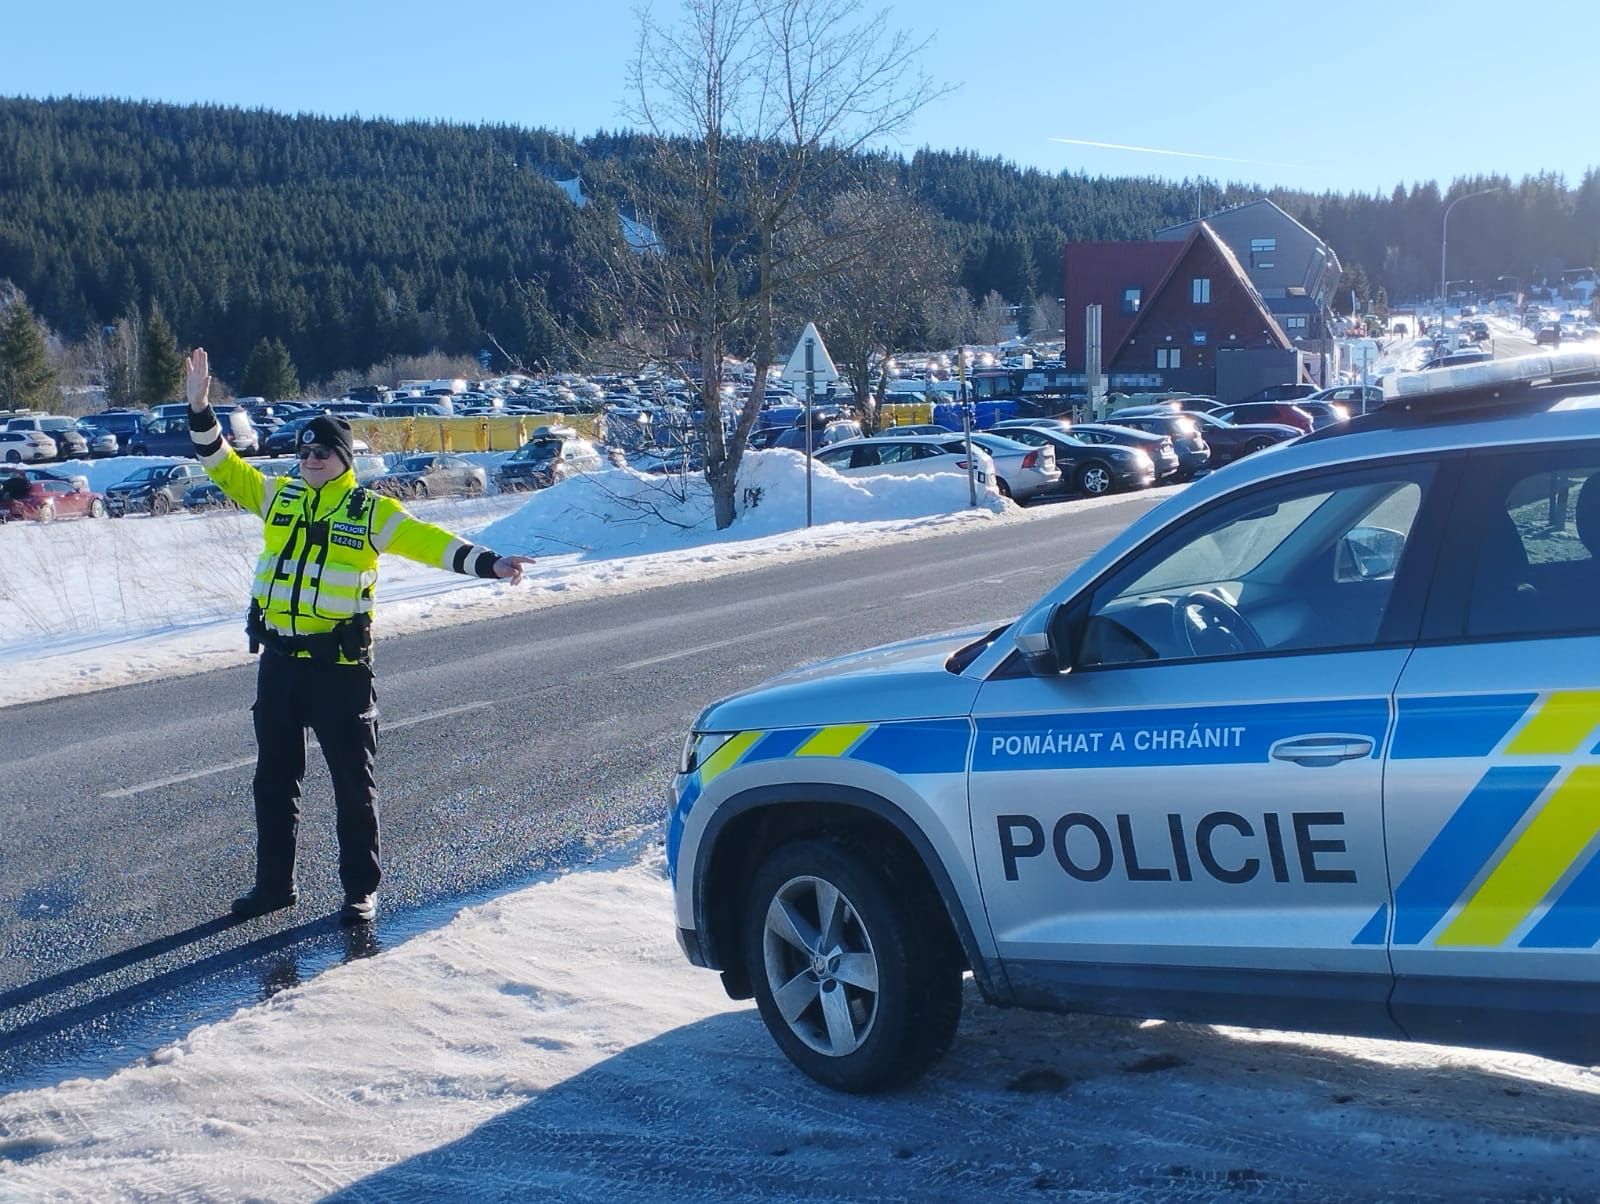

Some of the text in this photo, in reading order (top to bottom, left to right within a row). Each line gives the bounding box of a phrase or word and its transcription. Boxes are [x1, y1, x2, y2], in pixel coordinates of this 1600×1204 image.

[333, 523, 365, 534] POLICIE
[991, 723, 1246, 755] POMÁHAT A CHRÁNIT
[996, 811, 1358, 884] POLICIE
